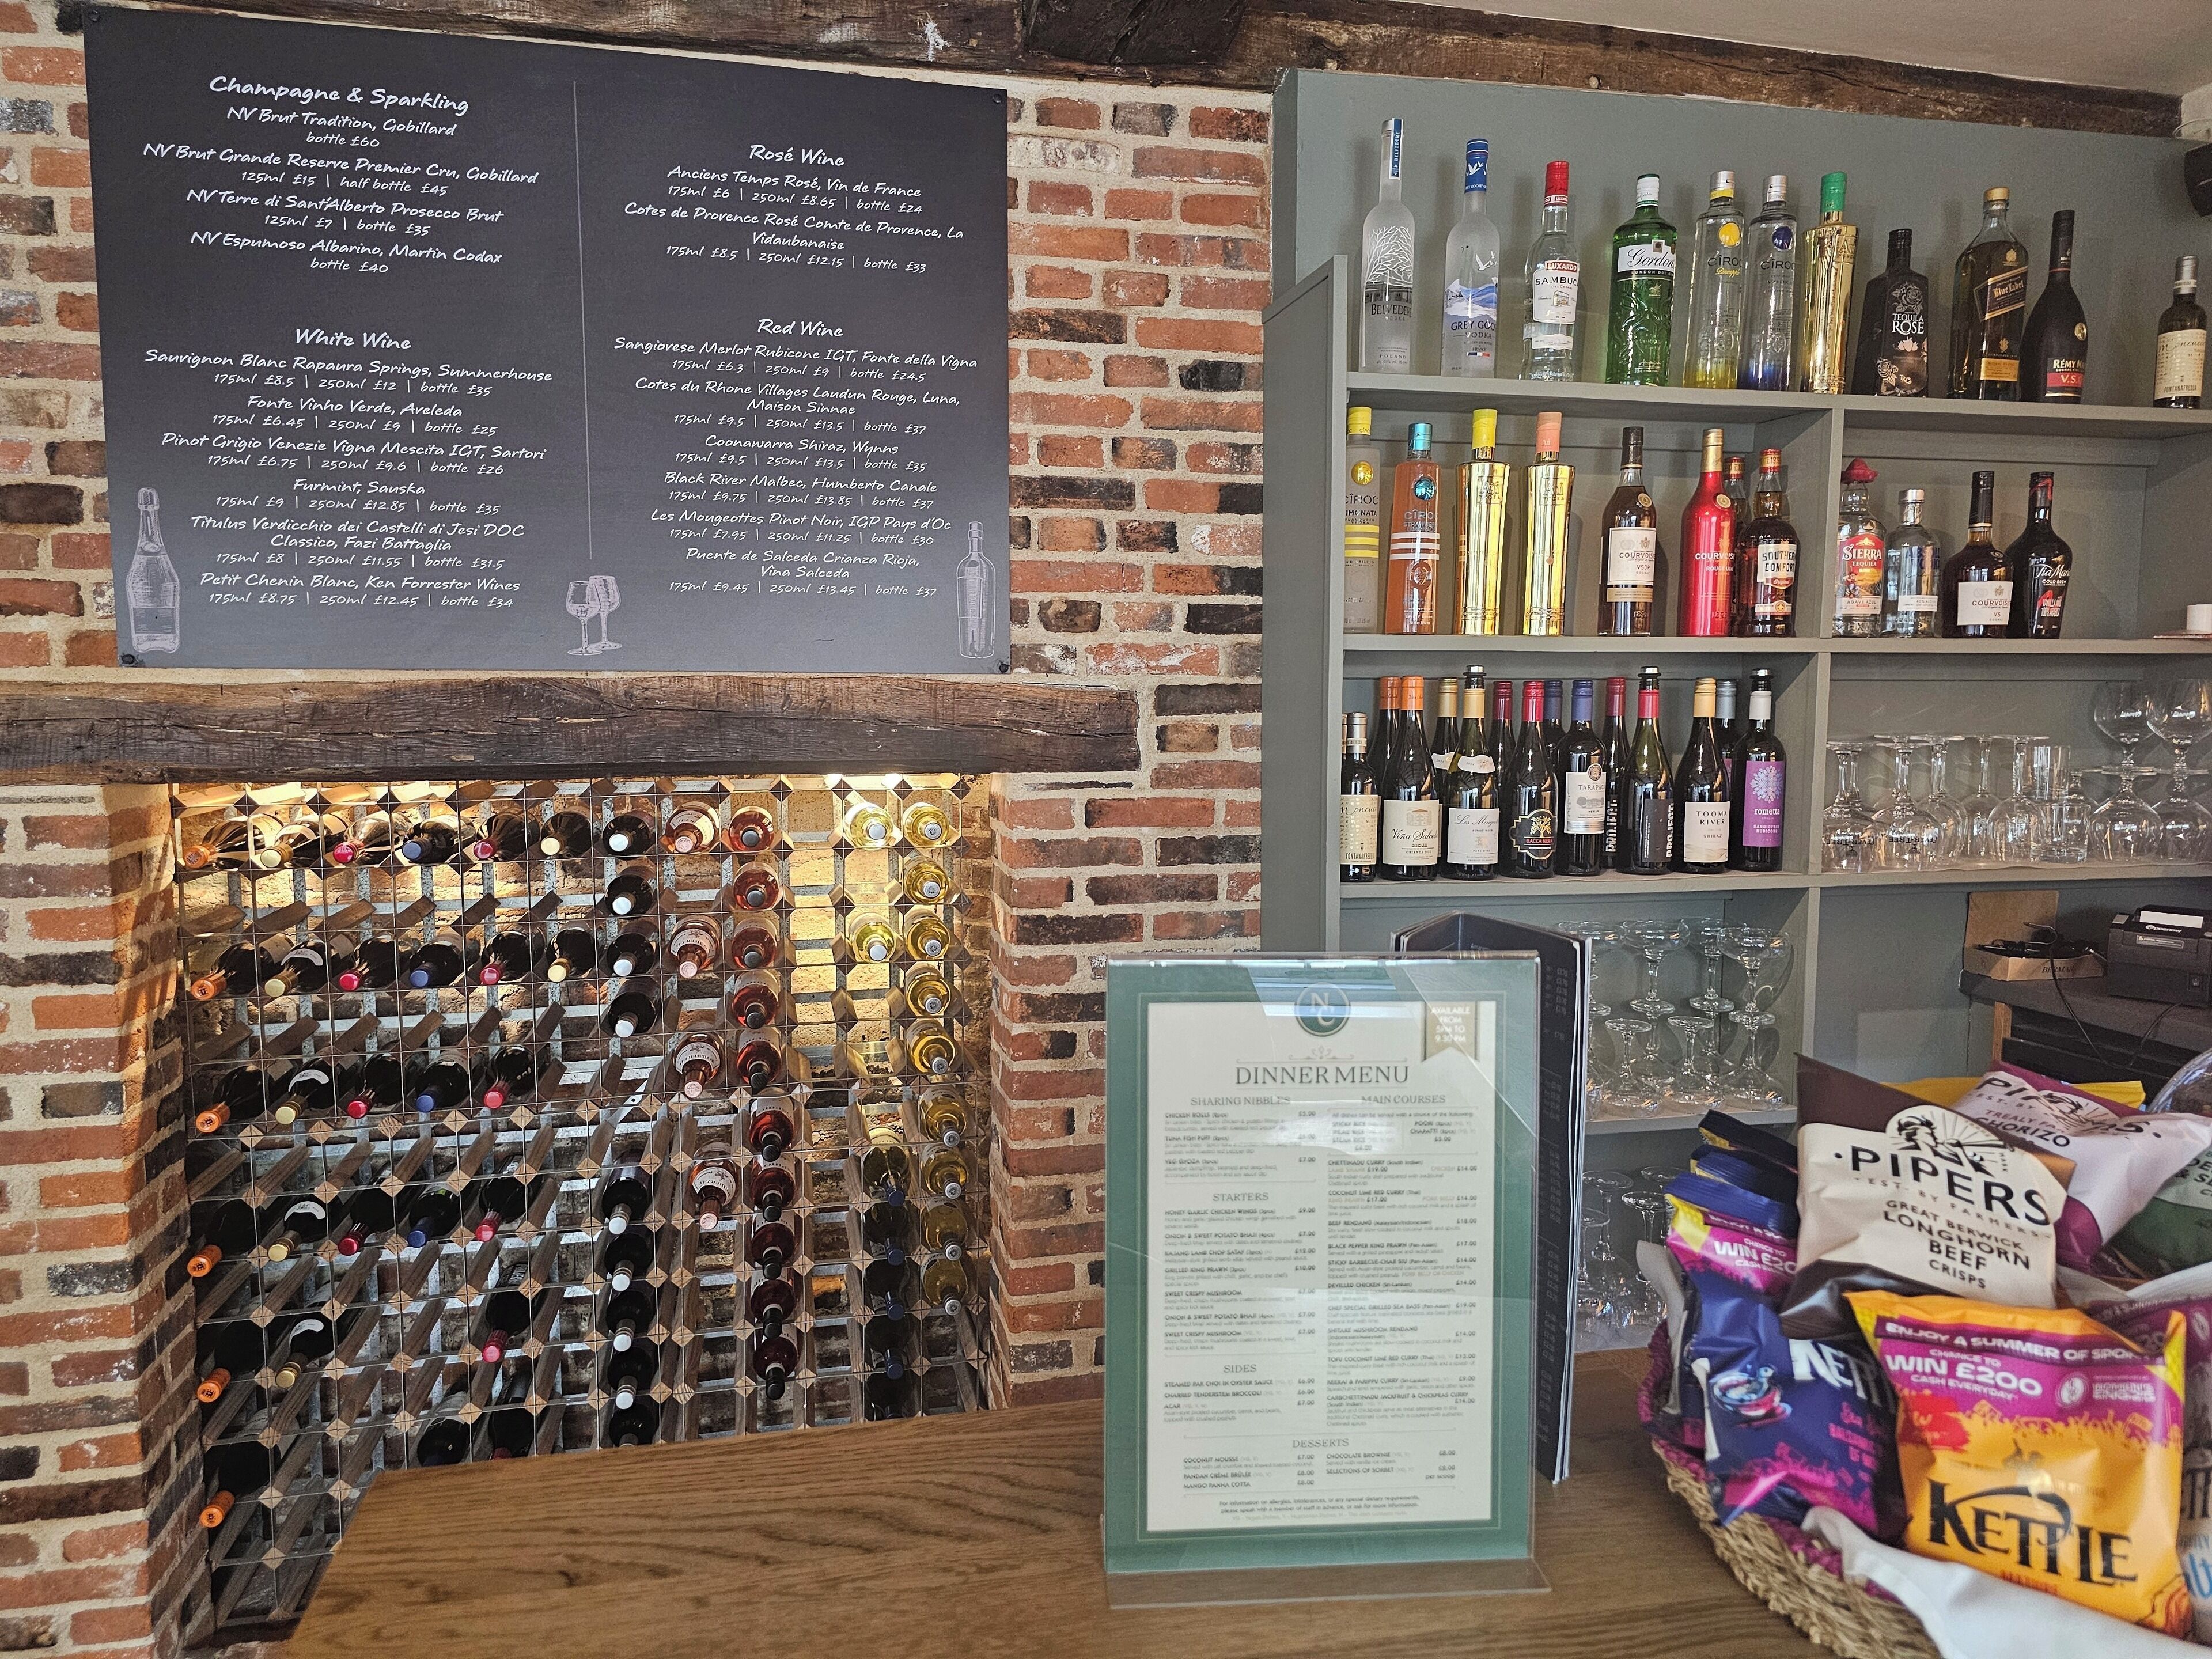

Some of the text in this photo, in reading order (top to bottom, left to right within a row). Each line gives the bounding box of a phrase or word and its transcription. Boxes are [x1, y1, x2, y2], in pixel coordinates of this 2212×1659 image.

[209, 75, 469, 117] Champagne & Sparkling
[226, 106, 457, 136] NV Brut Tradition, Gobillard
[749, 144, 844, 166] Rosé Wine
[666, 165, 922, 197] Anciens Temps Rosé, Vin de France
[186, 188, 505, 222] NV Terre di Sant'Alberto Prosecco Brut
[668, 185, 922, 214] 175ml £6 250ml £8.65 bottle £24
[1547, 262, 1577, 271] LUXARDO
[1535, 276, 1578, 286] SAMBUC
[1993, 280, 2024, 298] Blue Label
[1451, 320, 1496, 331] GREY GOO
[1892, 313, 1924, 322] TEQUILA
[757, 319, 843, 337] Red Wine
[1892, 320, 1924, 335] ROSE
[296, 328, 411, 349] White Wine
[145, 349, 552, 381] Sauvignon Blanc Rapaura Springs, Summerhouse
[2053, 359, 2075, 369] RÉMY
[214, 373, 493, 397] 175ml £8.5 250ml £12 bottle £35
[705, 434, 899, 459] Coonawarra Shiraz, Wynns
[293, 478, 425, 494] Furmint, Sauska
[664, 471, 938, 492] Black River Malbec, Humberto Canale
[1695, 552, 1736, 560] COURVOIS
[1842, 544, 1882, 561] SIERRA
[2033, 563, 2070, 578] Tia Mari
[1454, 815, 1470, 825] Les
[1392, 830, 1411, 840] Viña
[1431, 1006, 1470, 1014] AVAILABLE
[1236, 1066, 1409, 1084] DINNER MENU
[1191, 1096, 1291, 1105] SHARING NIBBLES
[1362, 1095, 1445, 1104] MAIN COURSES
[1986, 1109, 2035, 1123] TREALY
[1851, 1145, 2051, 1225] PIPERS
[1213, 1192, 1269, 1202] STARTERS
[1887, 1200, 2024, 1251] GREAT BERWICK
[1950, 1203, 2040, 1238] FARMERS
[1884, 1210, 2030, 1270] LONGHORN
[1714, 1240, 1758, 1261] WIN
[1929, 1239, 1987, 1270] BEEF
[1928, 1259, 1987, 1289] CRISPS
[1886, 1323, 1949, 1343] ENJOY
[1953, 1336, 1968, 1347] A
[1970, 1336, 2060, 1360] SUMMER
[2063, 1349, 2090, 1361] OF
[1929, 1349, 2001, 1367] CHANCE TO
[1223, 1364, 1257, 1373] SIDES
[1885, 1354, 2042, 1397] WIN £200
[1911, 1374, 2016, 1400] CASH EVERYDAY
[1293, 1438, 1349, 1448] DESSERTS
[1927, 1478, 2138, 1588] KETTLE
